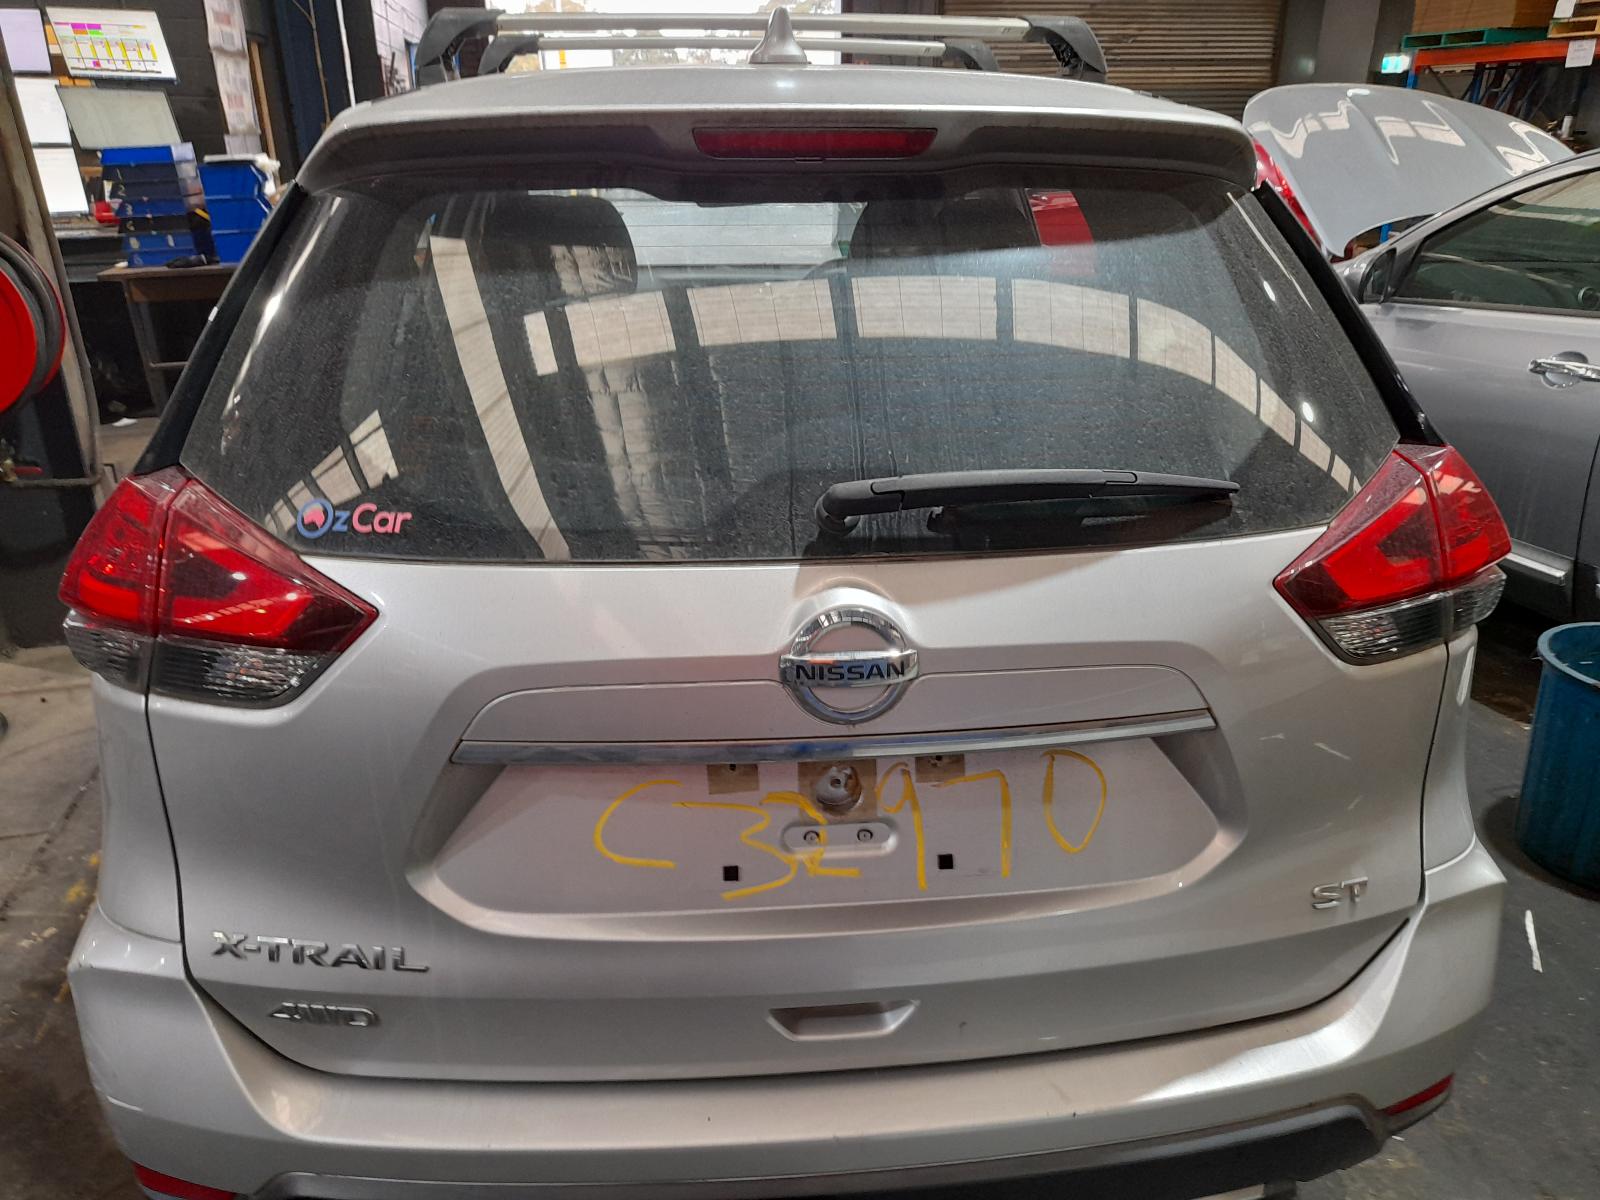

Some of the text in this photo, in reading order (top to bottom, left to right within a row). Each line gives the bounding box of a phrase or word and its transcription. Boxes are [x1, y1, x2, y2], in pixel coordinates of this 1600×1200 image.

[296, 498, 413, 539] OzCar
[795, 660, 905, 682] NISSAN
[1311, 876, 1369, 910] ST
[211, 930, 430, 972] X-TRAIL
[268, 1001, 380, 1028] 4WD
